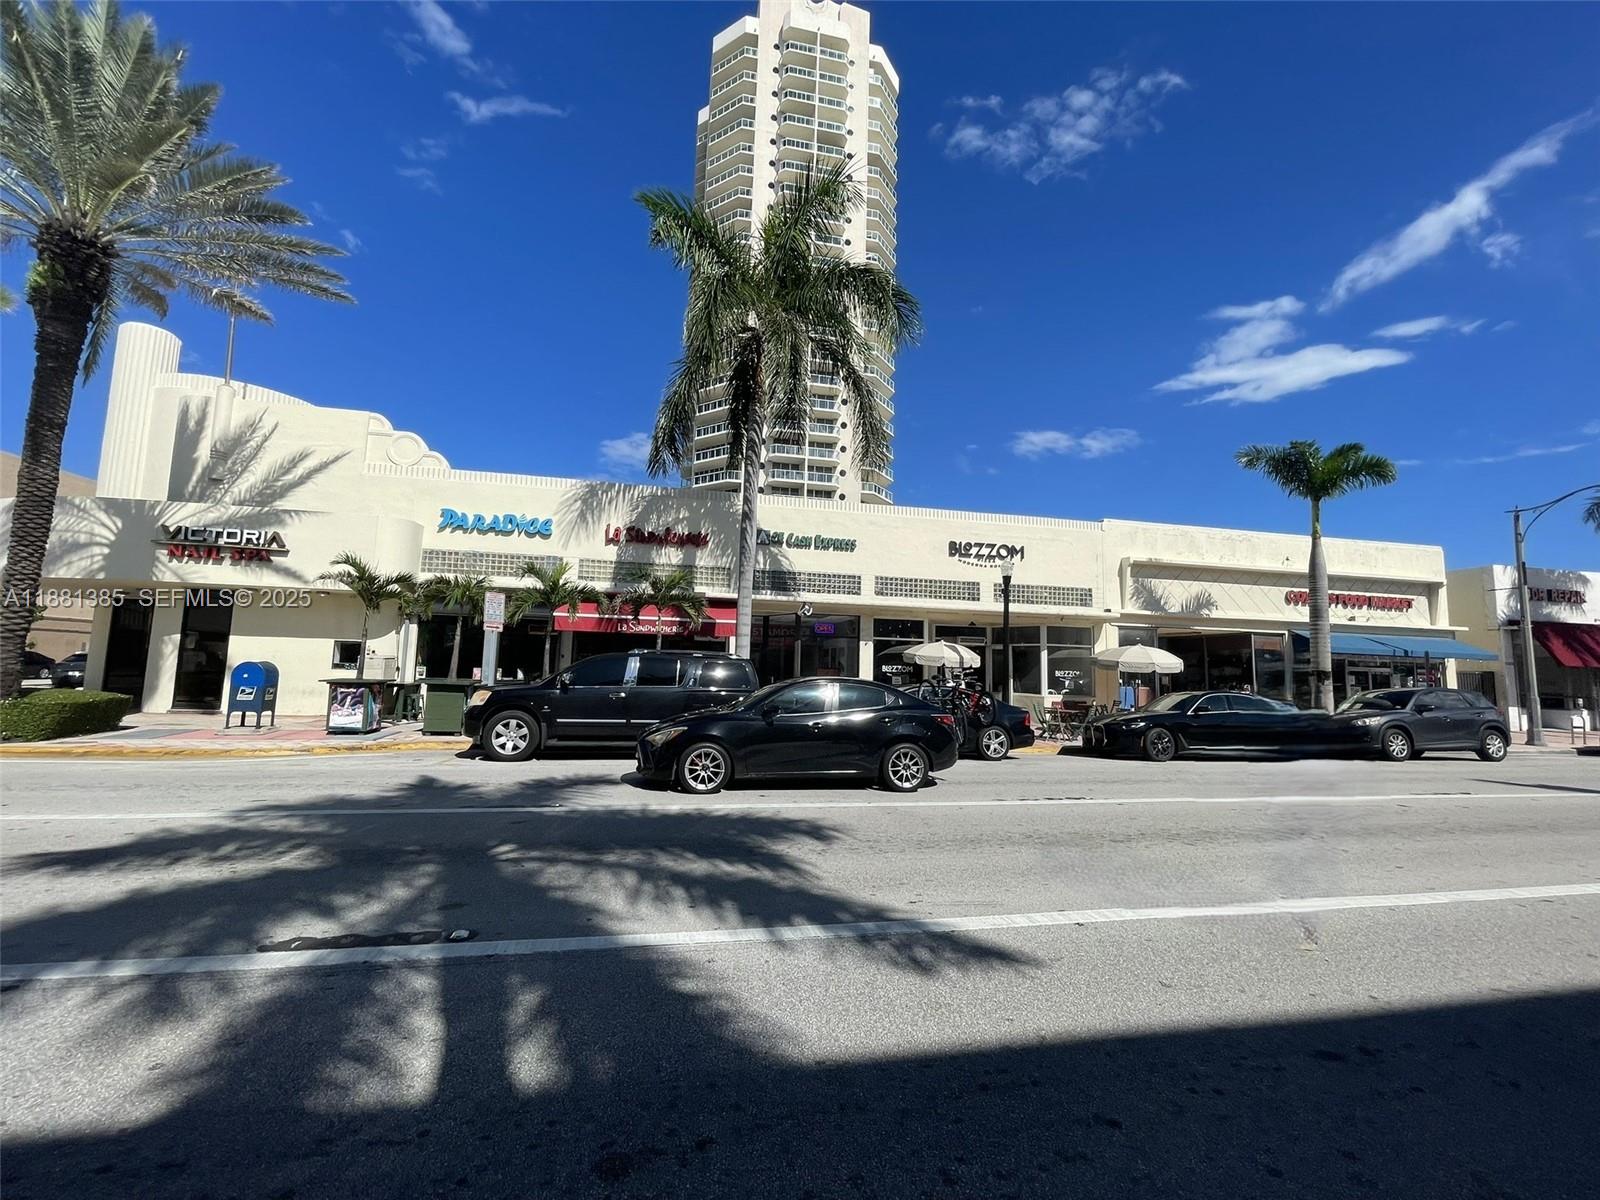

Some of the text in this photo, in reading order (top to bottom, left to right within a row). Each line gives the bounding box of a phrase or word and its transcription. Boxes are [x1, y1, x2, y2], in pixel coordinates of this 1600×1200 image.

[160, 524, 287, 549] VICTORIA
[167, 543, 274, 562] NAIL SPA
[1338, 593, 1369, 605] FOOD
[1370, 596, 1414, 609] MARKET
[1551, 589, 1586, 603] REPAIR
